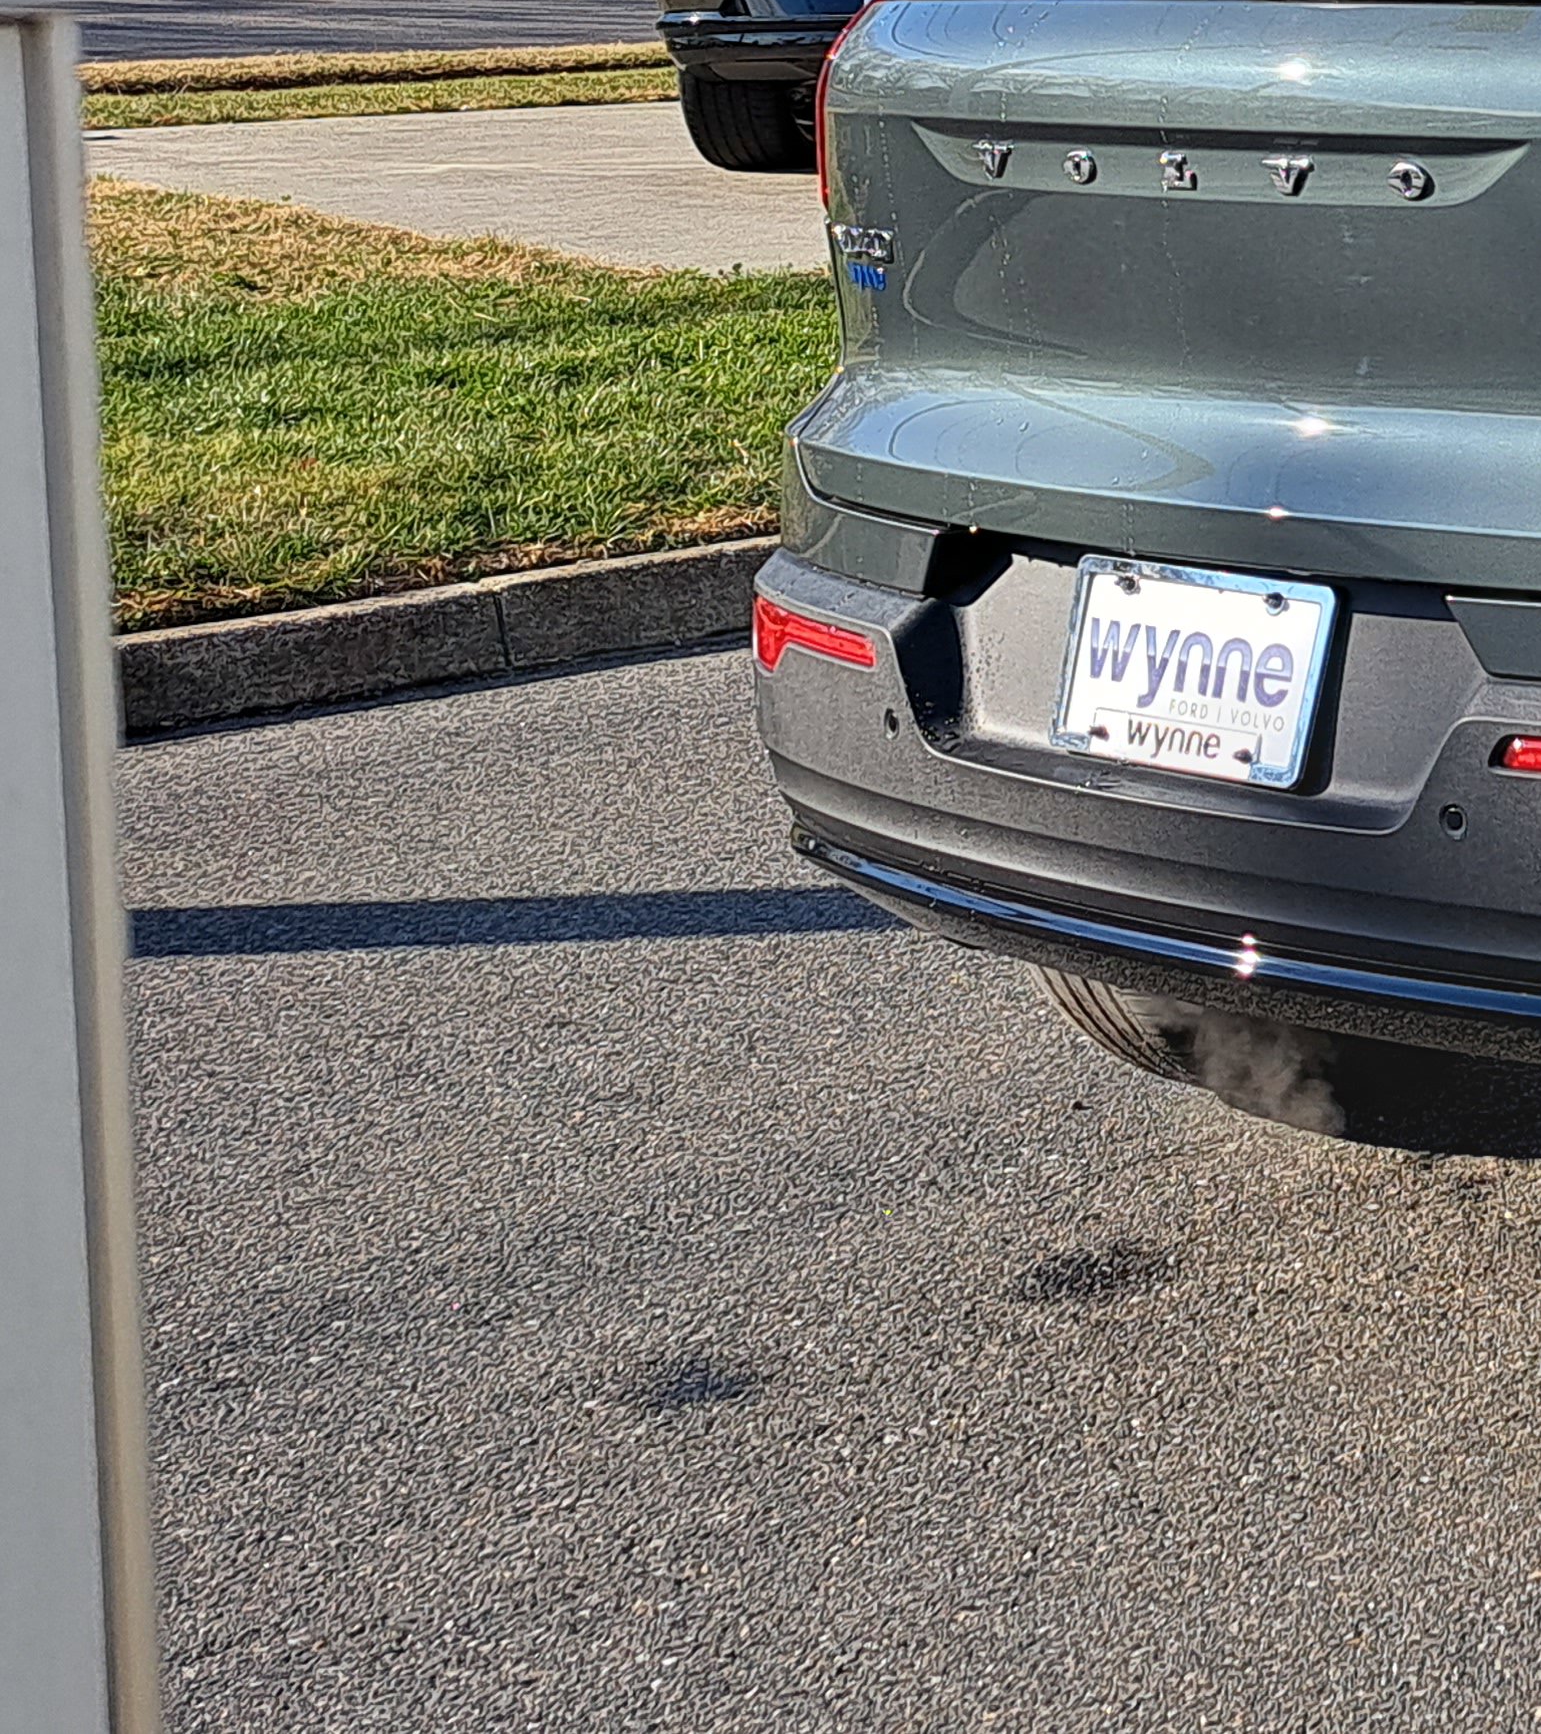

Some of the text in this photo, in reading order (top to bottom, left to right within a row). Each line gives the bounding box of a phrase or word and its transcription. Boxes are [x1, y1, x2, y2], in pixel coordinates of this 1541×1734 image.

[973, 139, 1435, 202] VOLVO
[1089, 616, 1295, 709] wynne
[1127, 718, 1221, 759] wynne
[1168, 698, 1208, 720] FORD
[1231, 708, 1285, 733] VOLVO
